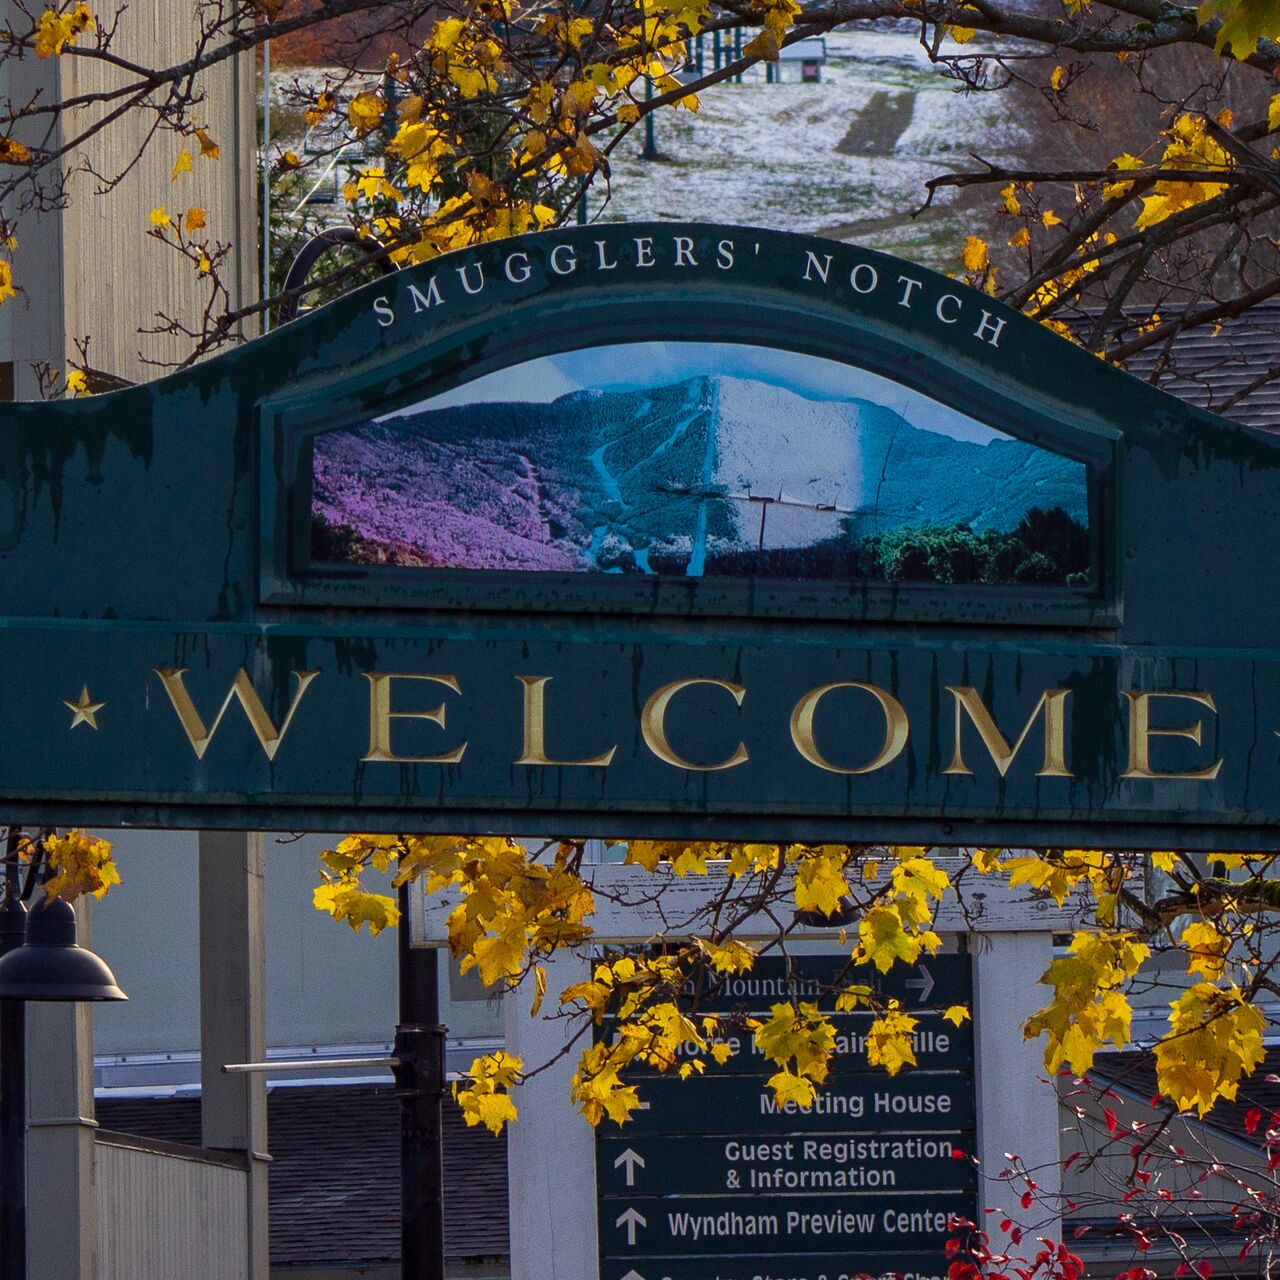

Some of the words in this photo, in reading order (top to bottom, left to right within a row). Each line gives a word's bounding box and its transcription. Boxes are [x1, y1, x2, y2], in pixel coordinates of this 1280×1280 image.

[373, 237, 761, 327] SMUGGLERS'
[802, 250, 1008, 348] NOTCH
[151, 666, 1224, 781] WELCOME
[874, 1093, 951, 1114] House
[724, 1140, 794, 1161] Guest
[803, 1138, 953, 1163] Registration
[726, 1169, 741, 1188] &
[751, 1167, 896, 1188] Information
[668, 1210, 778, 1240] Wyndham
[787, 1209, 876, 1234] Preview
[883, 1209, 956, 1233] Center
